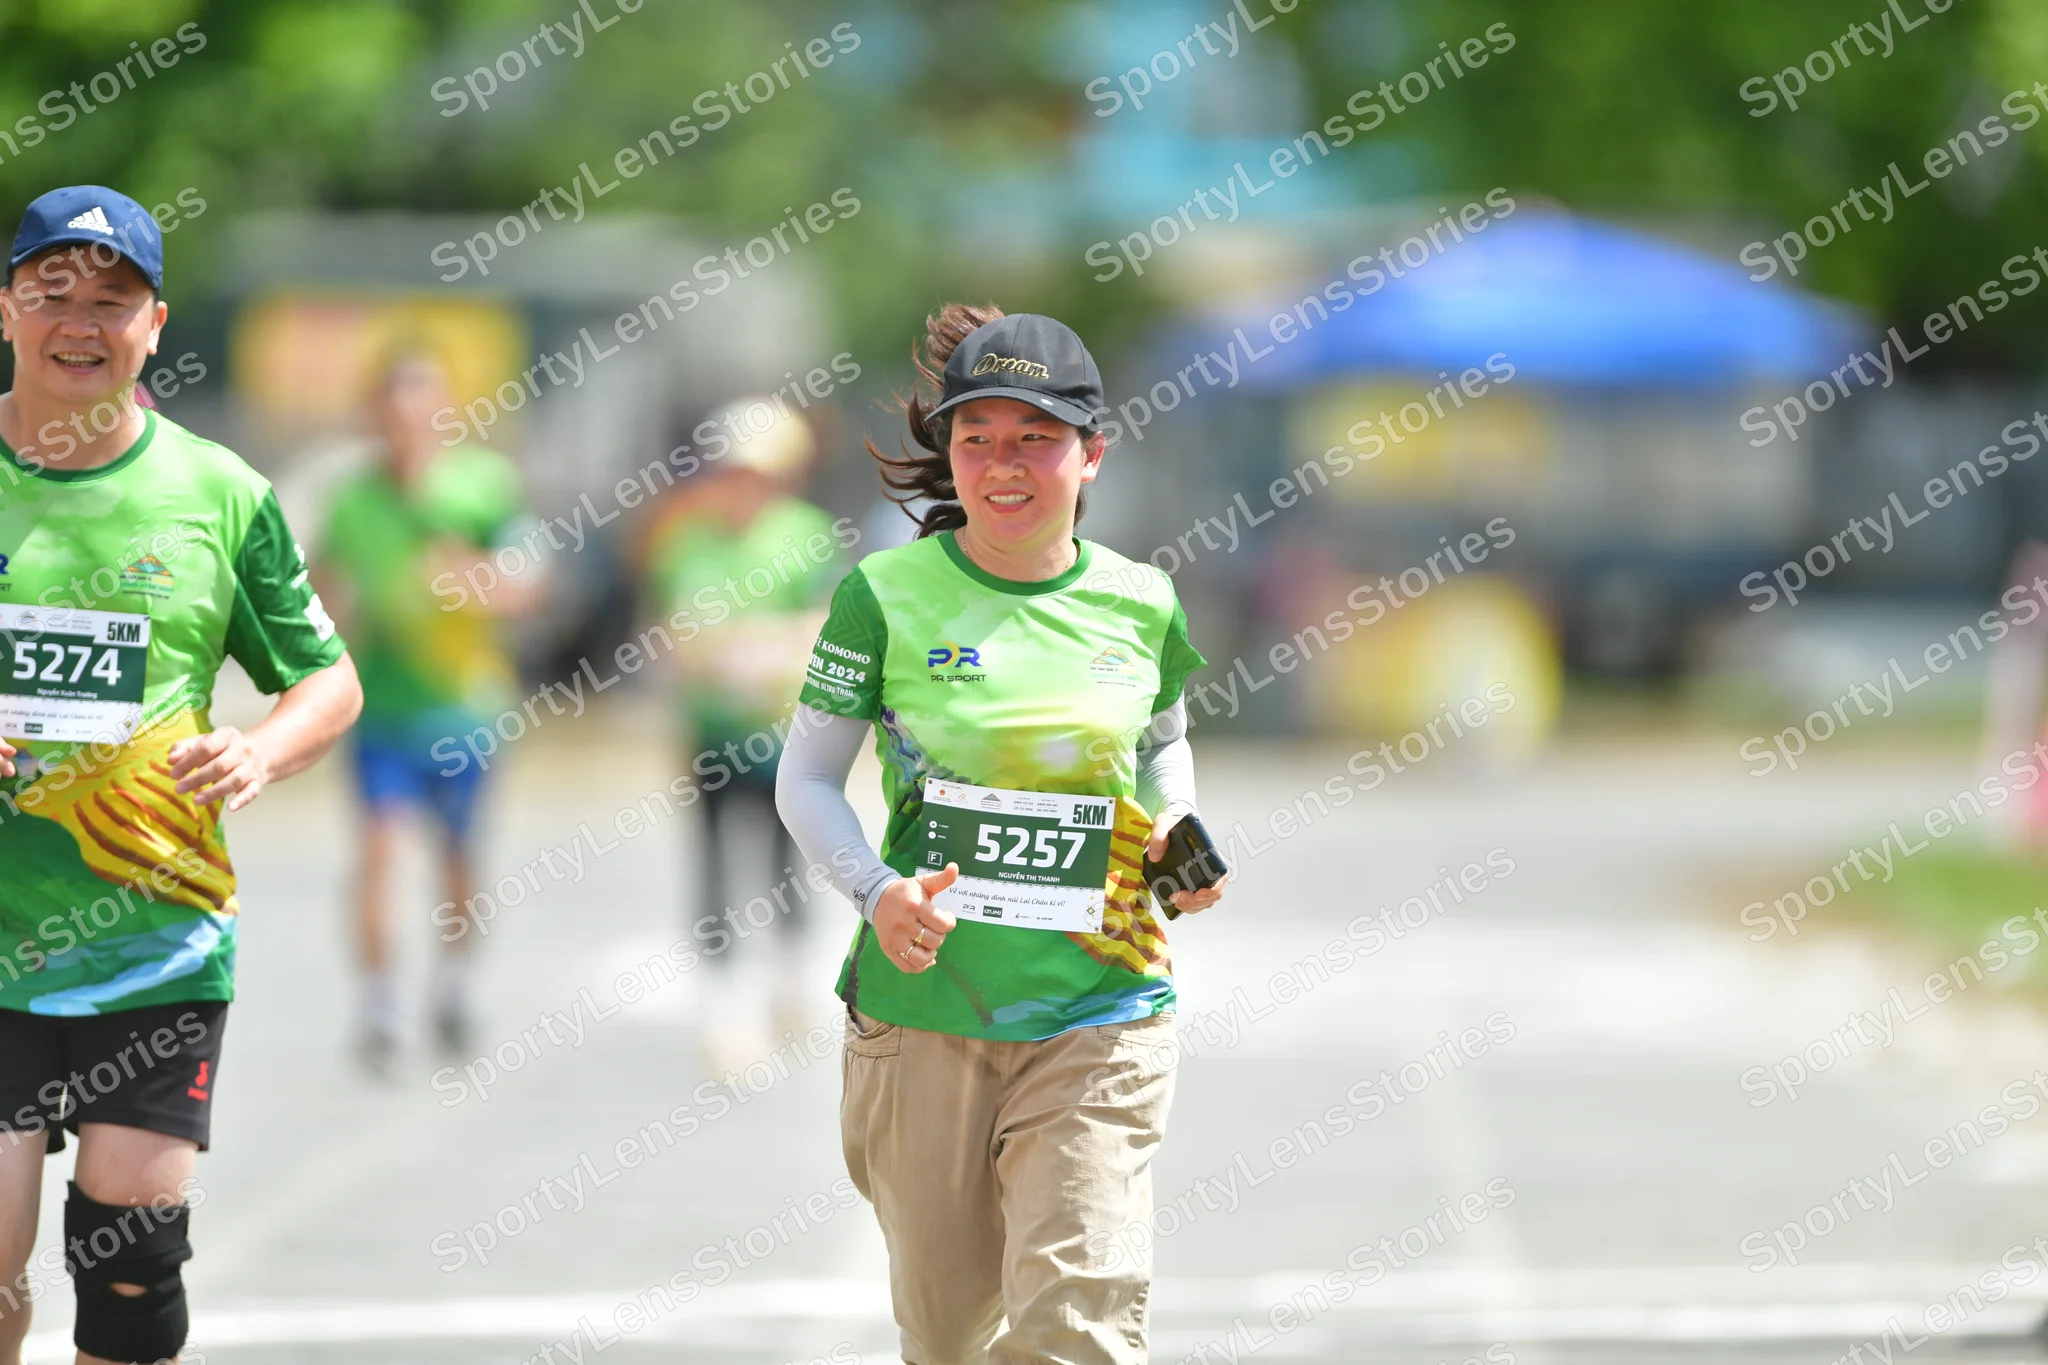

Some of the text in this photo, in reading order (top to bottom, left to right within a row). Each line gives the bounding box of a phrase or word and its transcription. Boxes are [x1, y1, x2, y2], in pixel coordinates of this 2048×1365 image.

[971, 352, 1049, 379] Dream
[107, 621, 141, 643] 5KM
[821, 640, 871, 664] KOMOMO
[12, 641, 122, 686] 5274
[826, 662, 866, 683] 2024
[930, 674, 987, 682] PR SPORT
[1072, 803, 1107, 826] 5KM
[930, 853, 937, 862] F
[974, 823, 1087, 870] 5257
[1038, 875, 1061, 883] THANH
